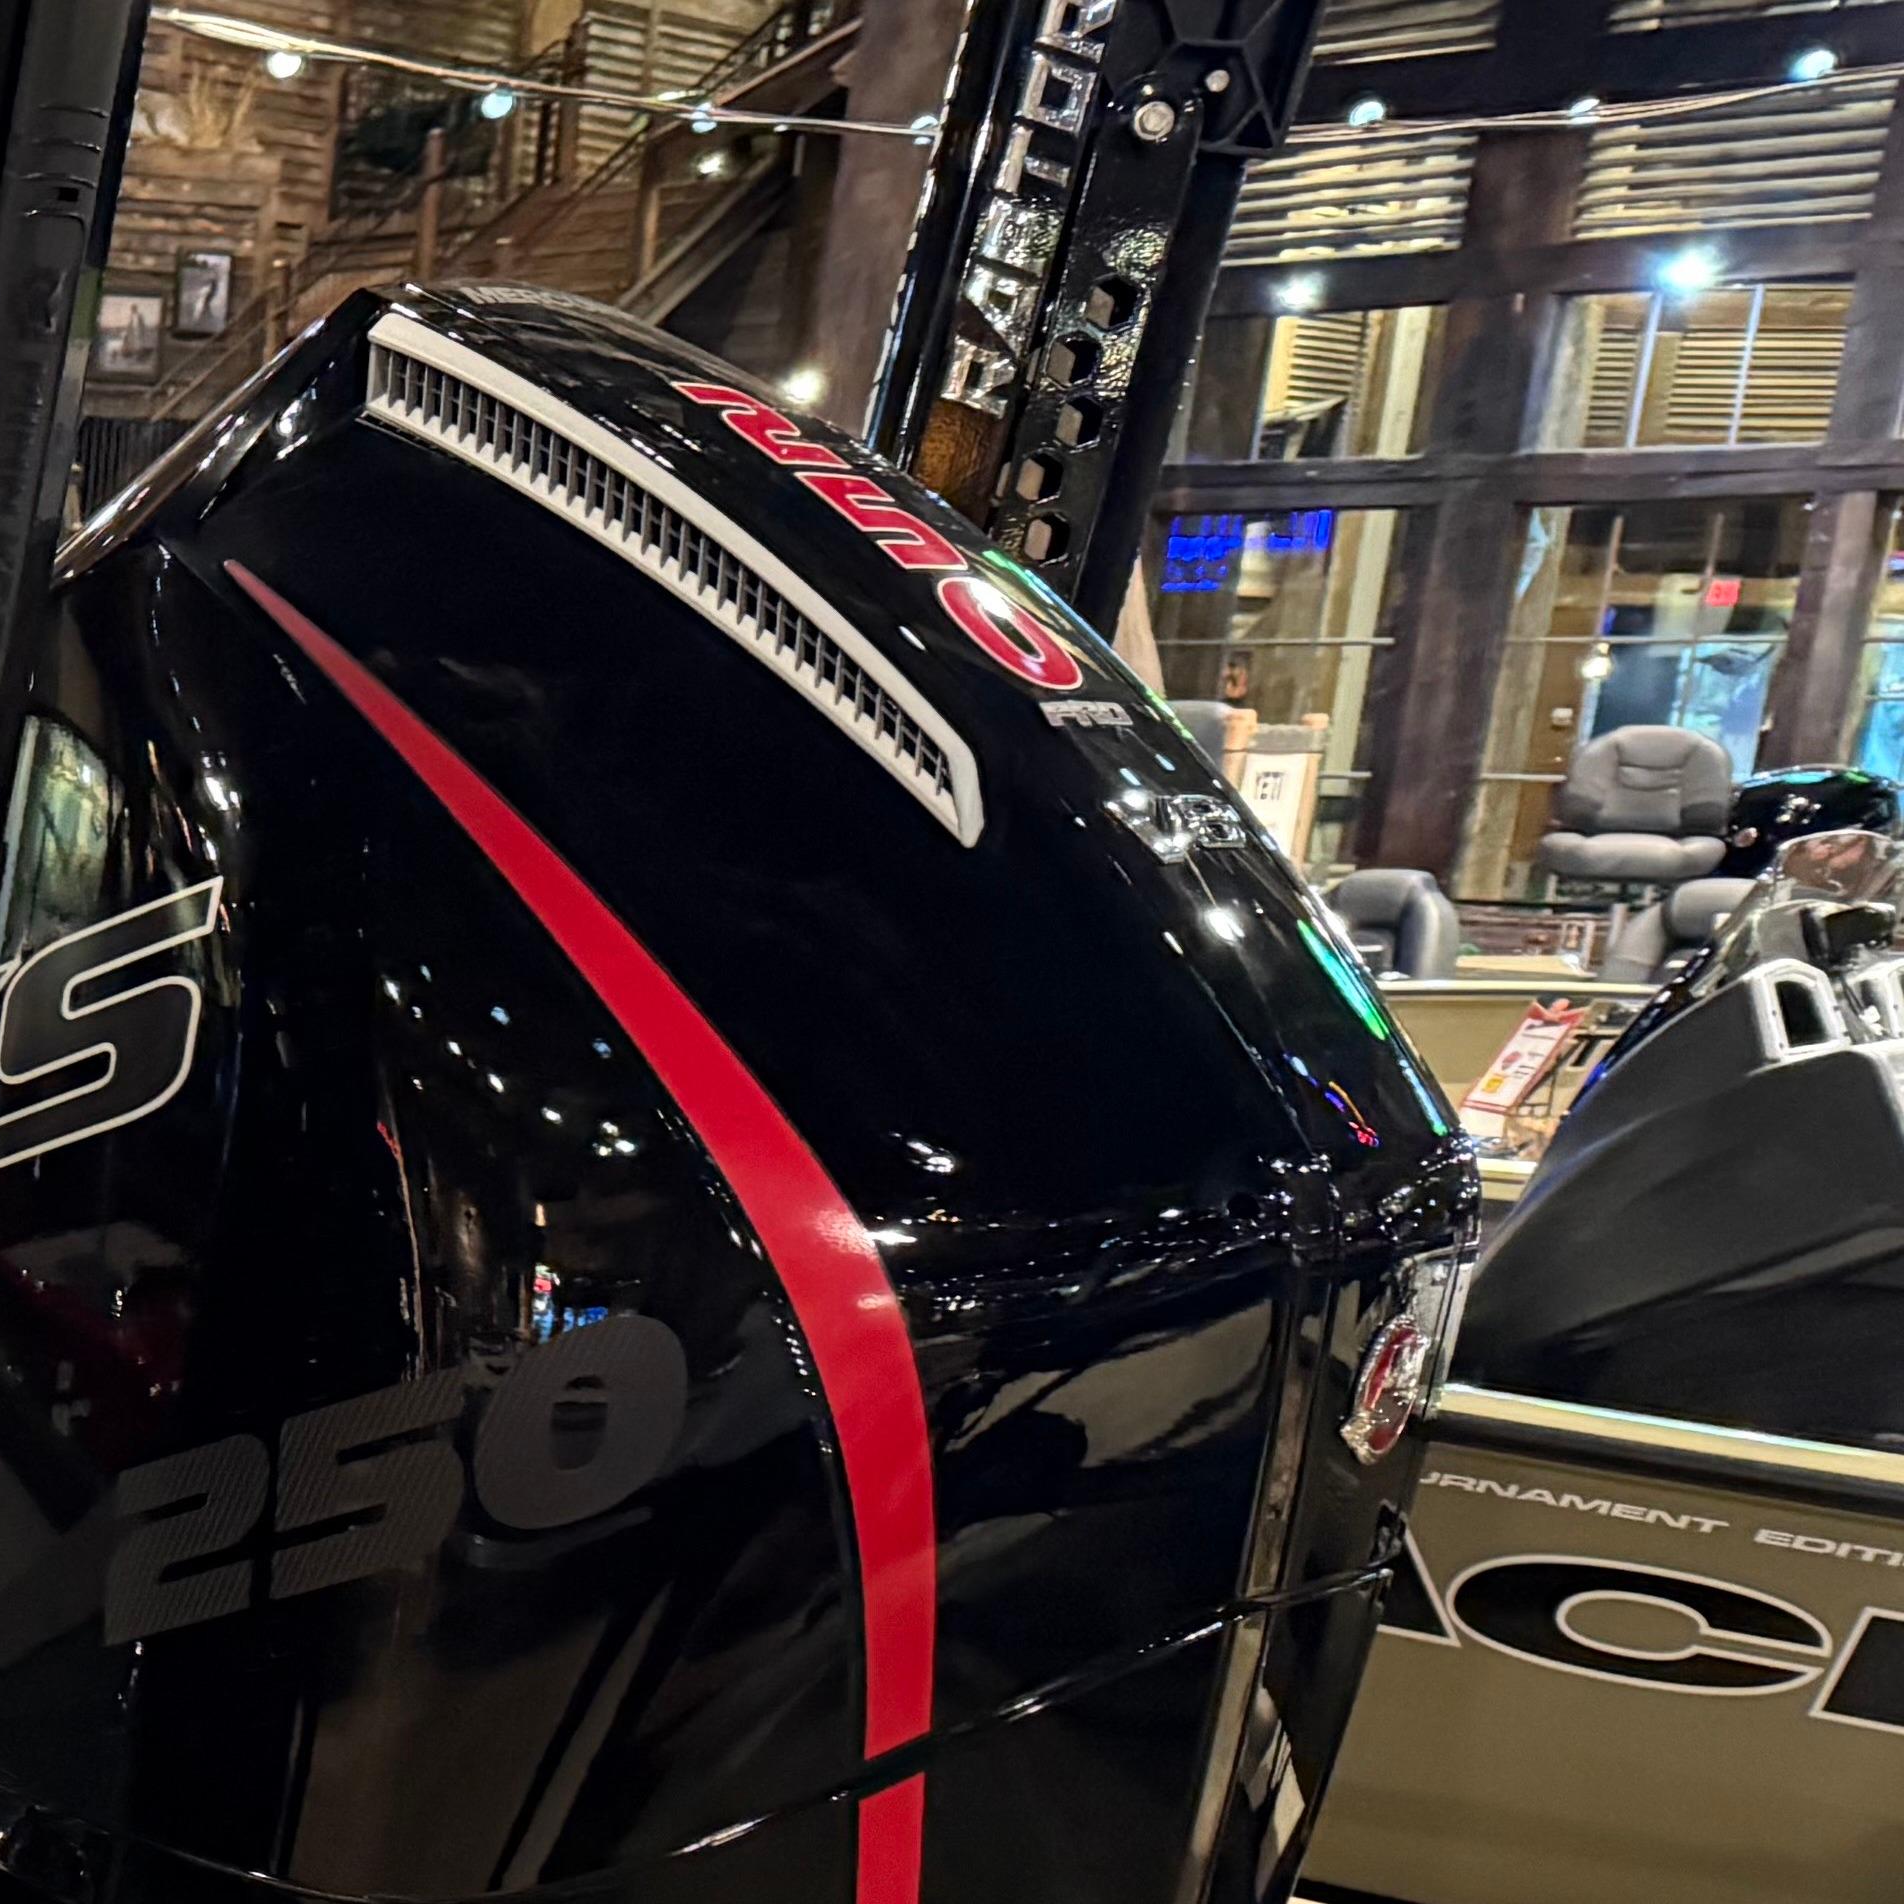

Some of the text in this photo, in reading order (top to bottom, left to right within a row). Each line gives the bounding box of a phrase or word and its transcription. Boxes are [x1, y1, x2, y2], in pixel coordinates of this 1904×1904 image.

[1039, 700, 1133, 727] PRO
[1103, 789, 1247, 865] V8
[103, 1314, 687, 1646] 250
[1418, 1472, 1904, 1567] URNAMENT EDITI
